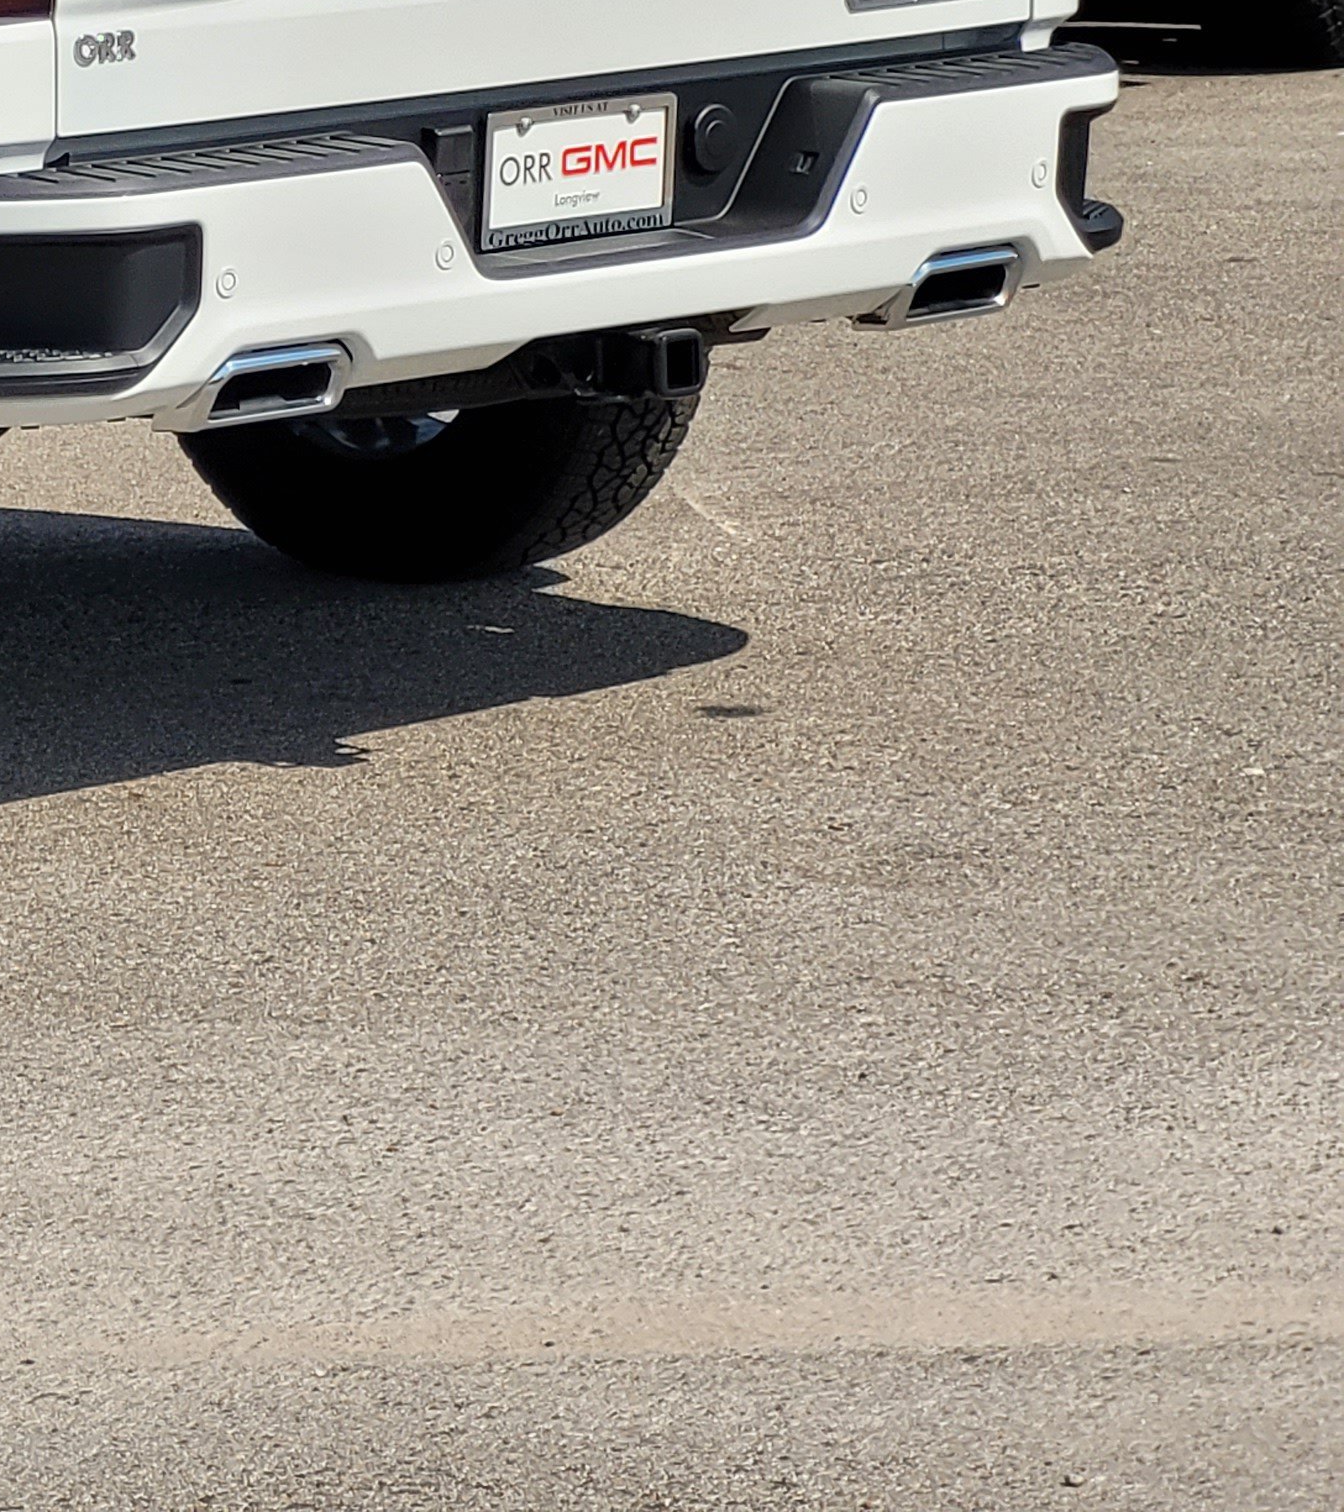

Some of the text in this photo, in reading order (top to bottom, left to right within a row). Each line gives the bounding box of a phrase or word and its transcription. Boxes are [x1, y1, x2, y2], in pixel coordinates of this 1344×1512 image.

[72, 29, 137, 68] ORR
[499, 136, 658, 187] ORR GMC
[554, 189, 601, 208] Longview
[488, 212, 664, 247] GreggOrrAuto.com
